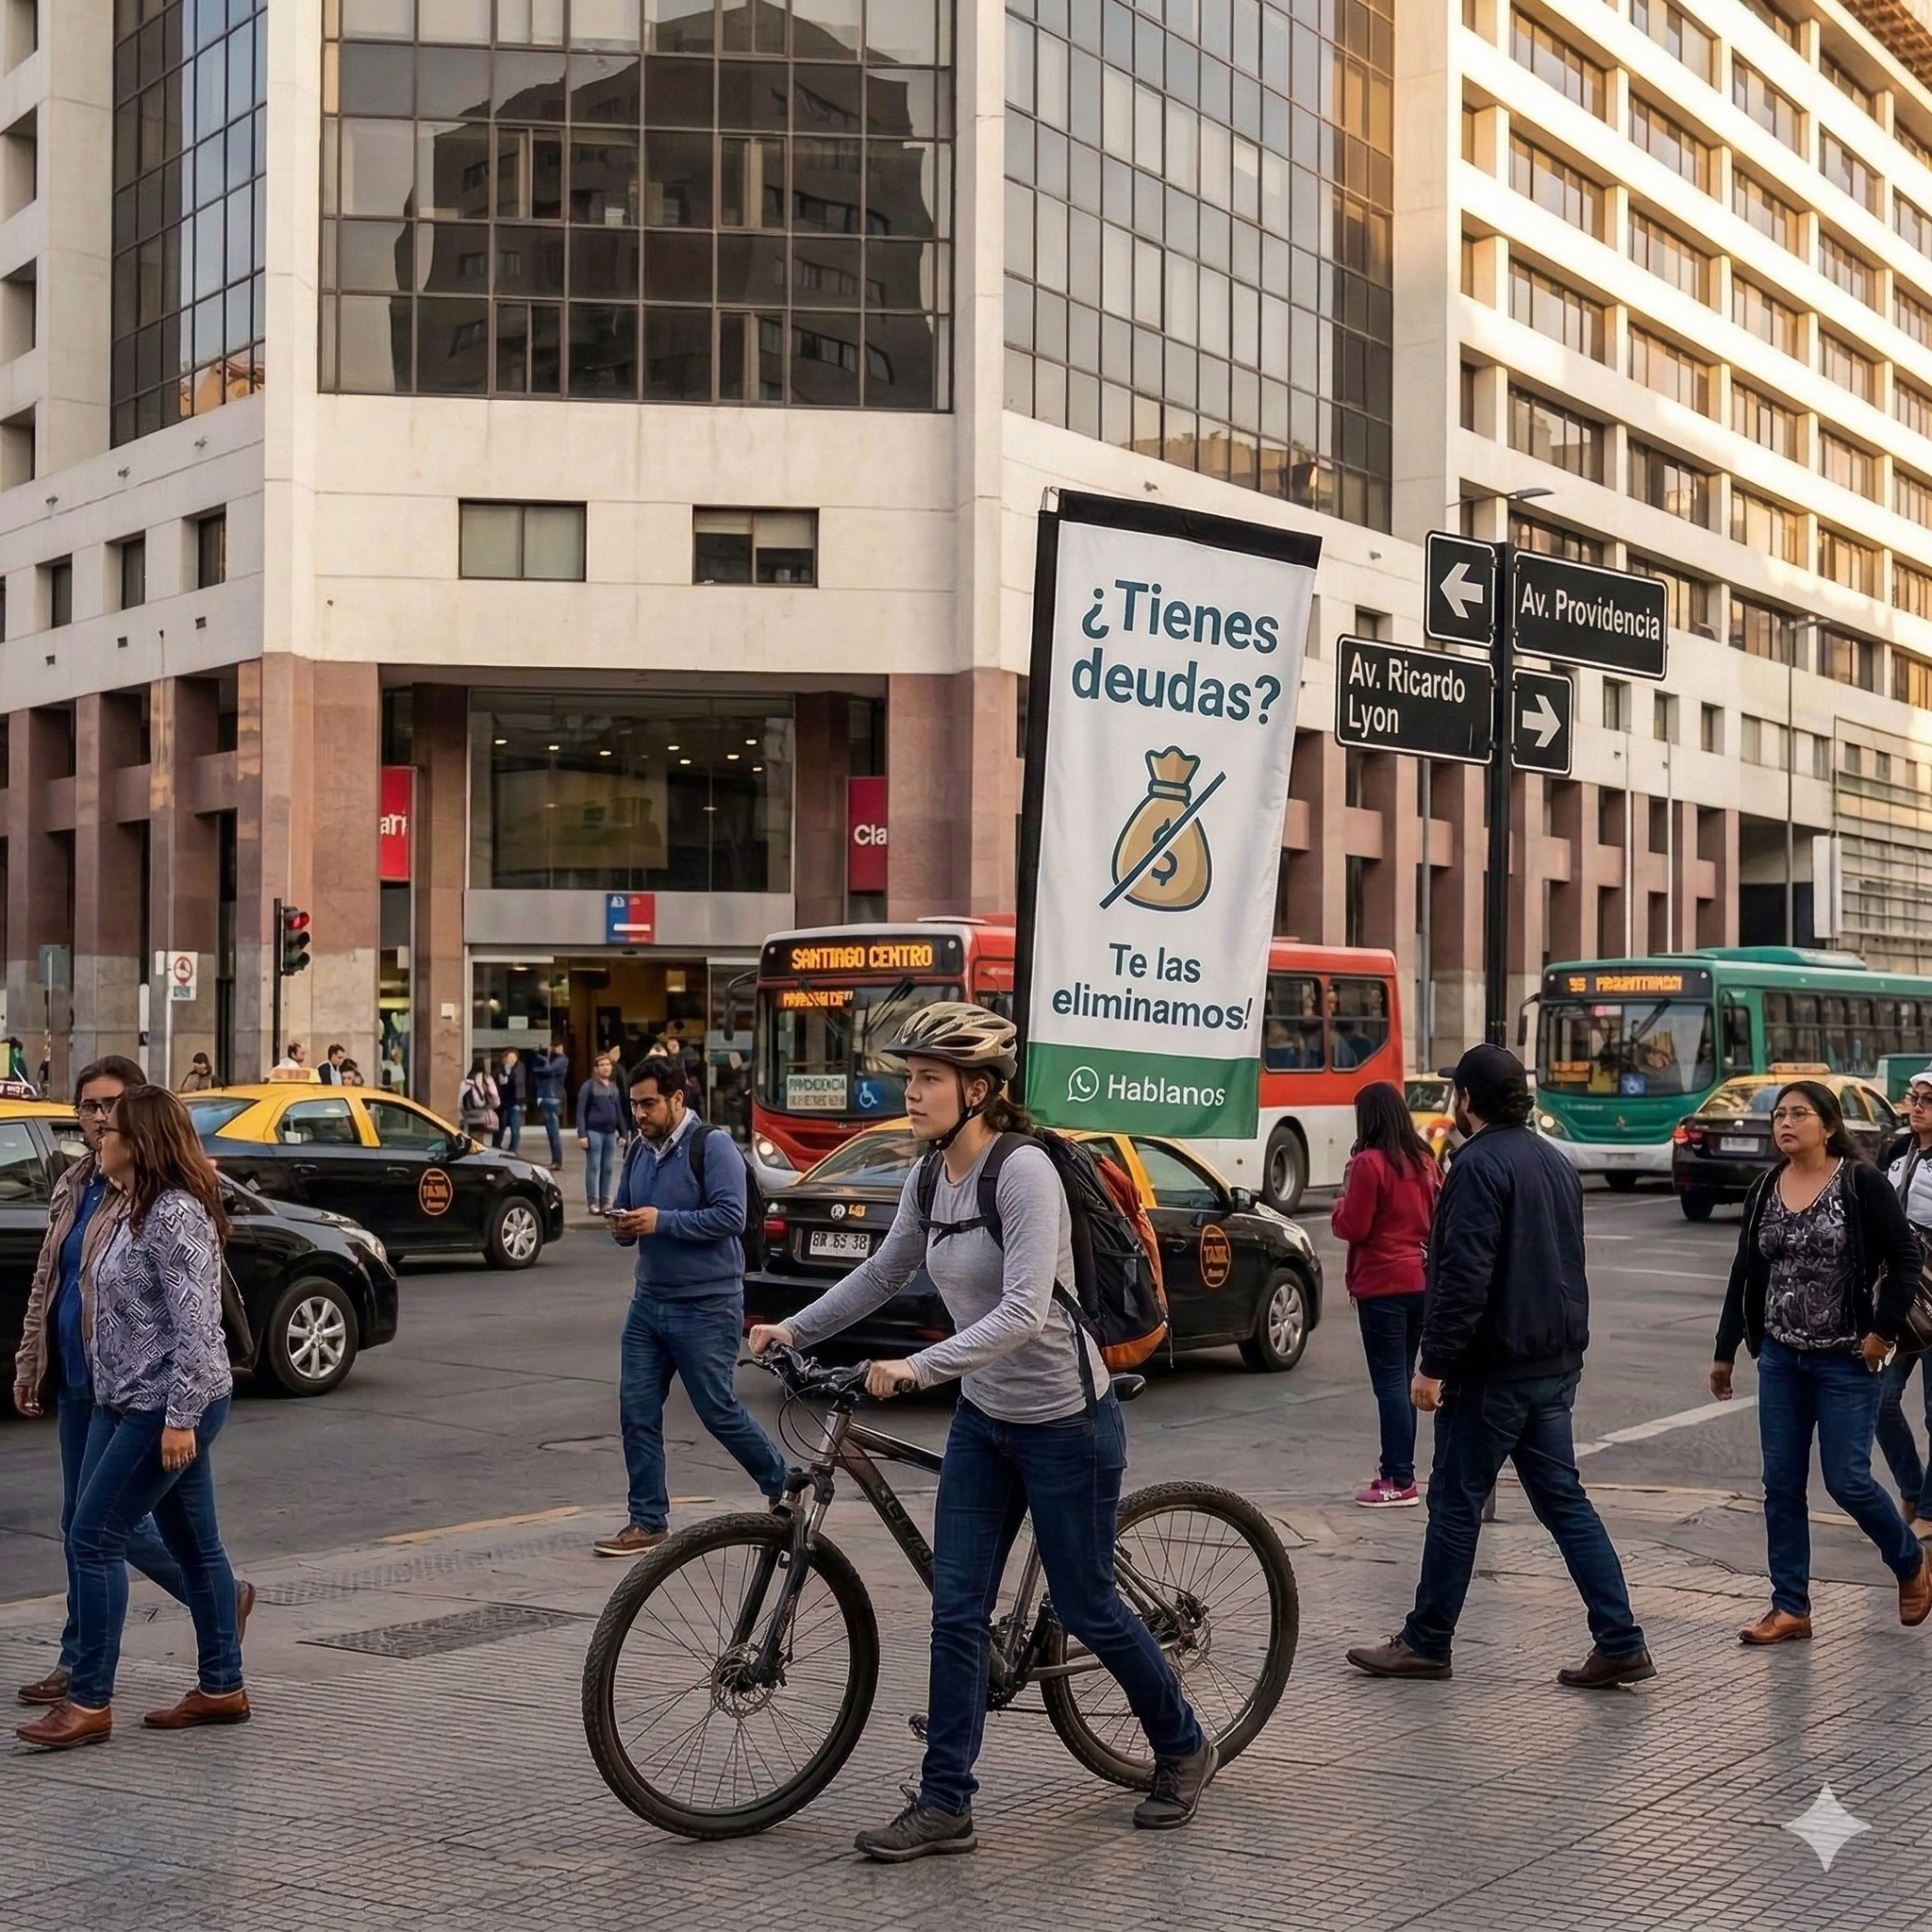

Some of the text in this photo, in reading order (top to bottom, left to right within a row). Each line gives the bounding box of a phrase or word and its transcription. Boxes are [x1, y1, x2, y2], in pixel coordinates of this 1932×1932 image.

[1081, 578, 1280, 655] ¿Tienes
[1520, 582, 1661, 641] Av. Providencia
[1071, 646, 1282, 724] deudas?
[1348, 652, 1466, 704] Av. Ricardo
[1348, 693, 1399, 739] Lyon
[868, 944, 933, 968] CENTRO
[1108, 942, 1201, 983] Te las
[1052, 981, 1254, 1031] eliminamos!
[1107, 1074, 1226, 1108] Hablanos
